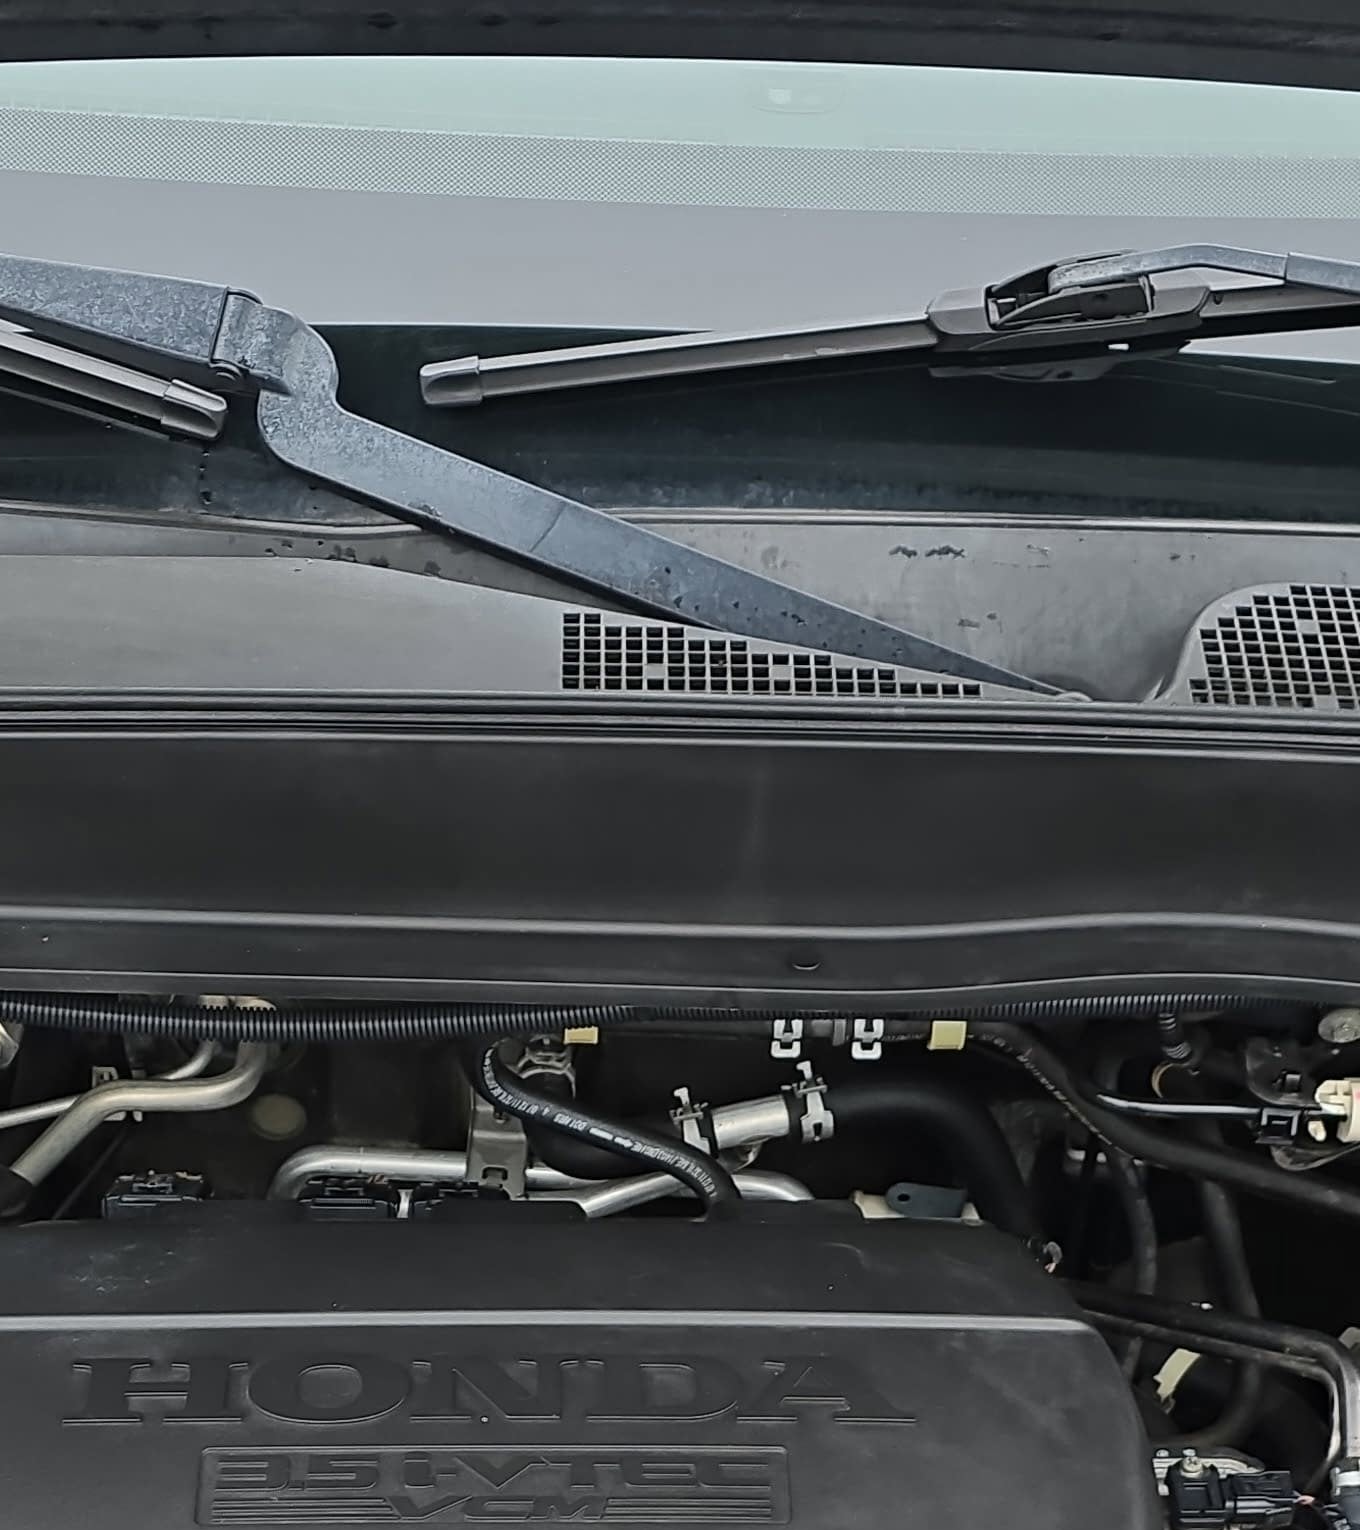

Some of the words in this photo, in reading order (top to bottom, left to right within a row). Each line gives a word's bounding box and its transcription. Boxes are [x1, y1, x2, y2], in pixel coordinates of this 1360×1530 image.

[62, 1355, 917, 1425] HONDA
[214, 1455, 381, 1492] 3.5
[385, 1495, 606, 1523] VCM
